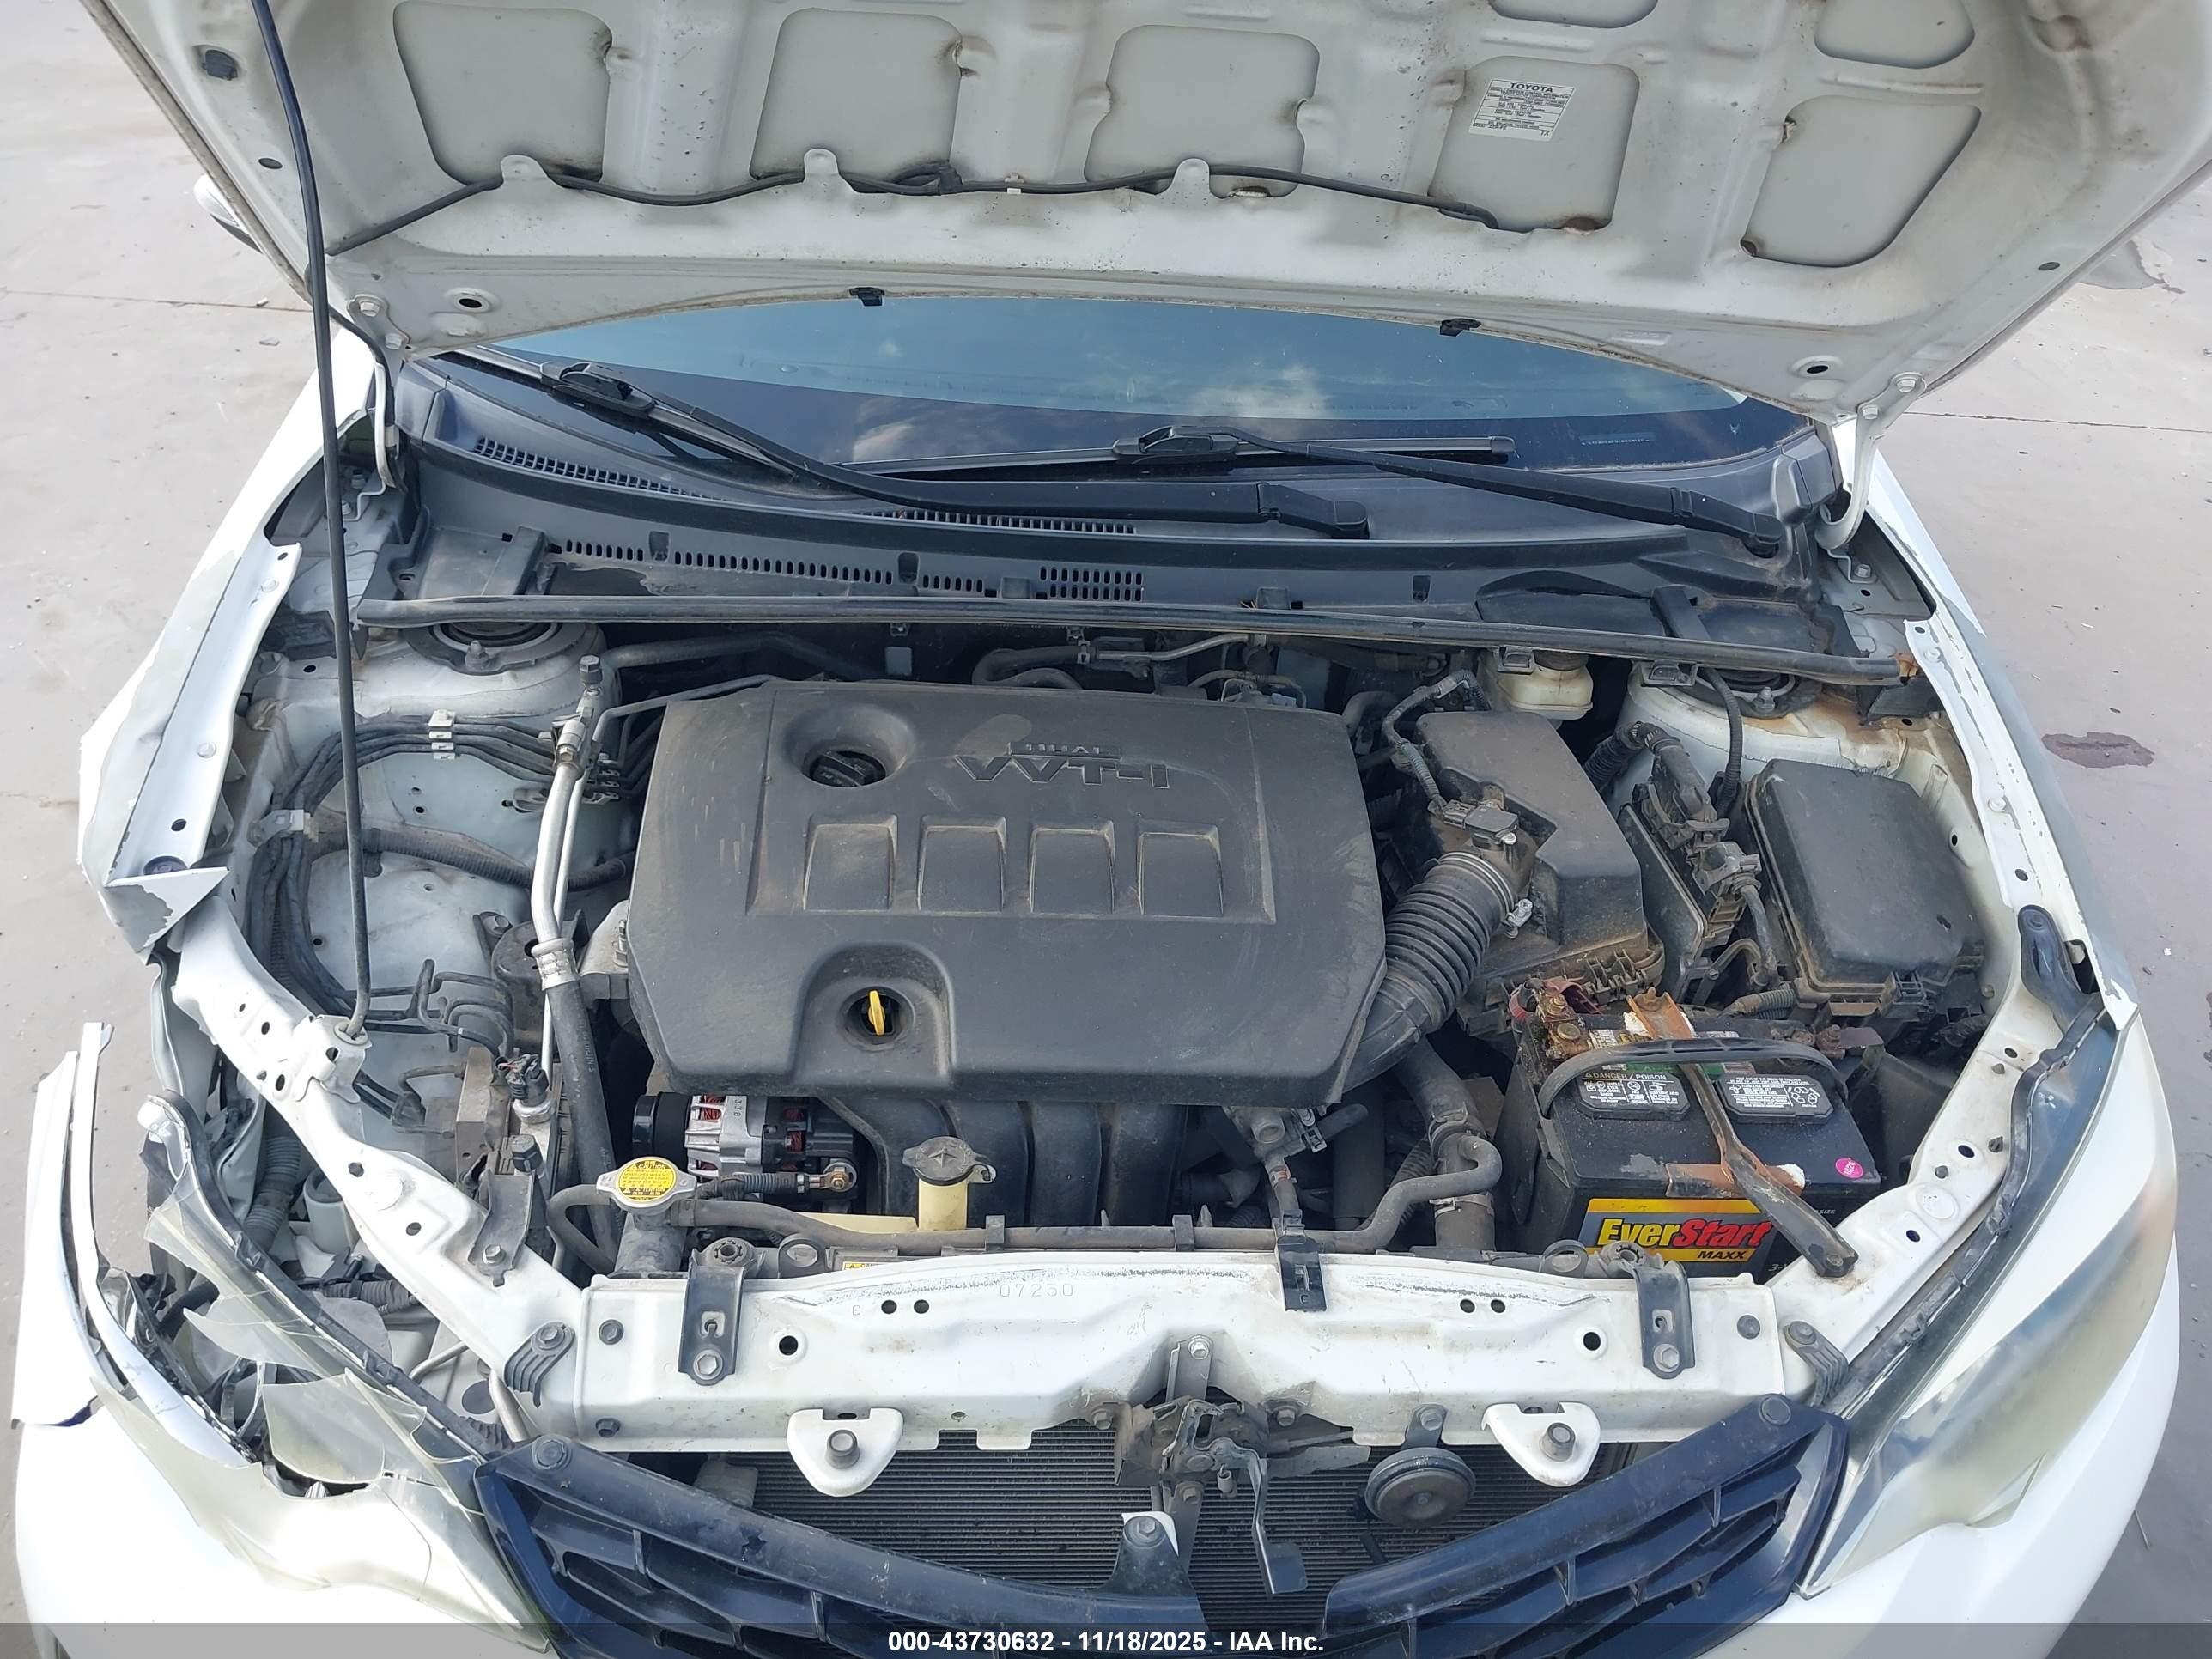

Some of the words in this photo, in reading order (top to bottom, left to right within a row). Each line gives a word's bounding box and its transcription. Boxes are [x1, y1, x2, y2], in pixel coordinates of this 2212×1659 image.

[1511, 82, 1553, 93] TOYOTA
[1596, 1218, 1773, 1249] EverStart
[1697, 1250, 1747, 1260] MAXX
[1000, 1283, 1073, 1297] 07250
